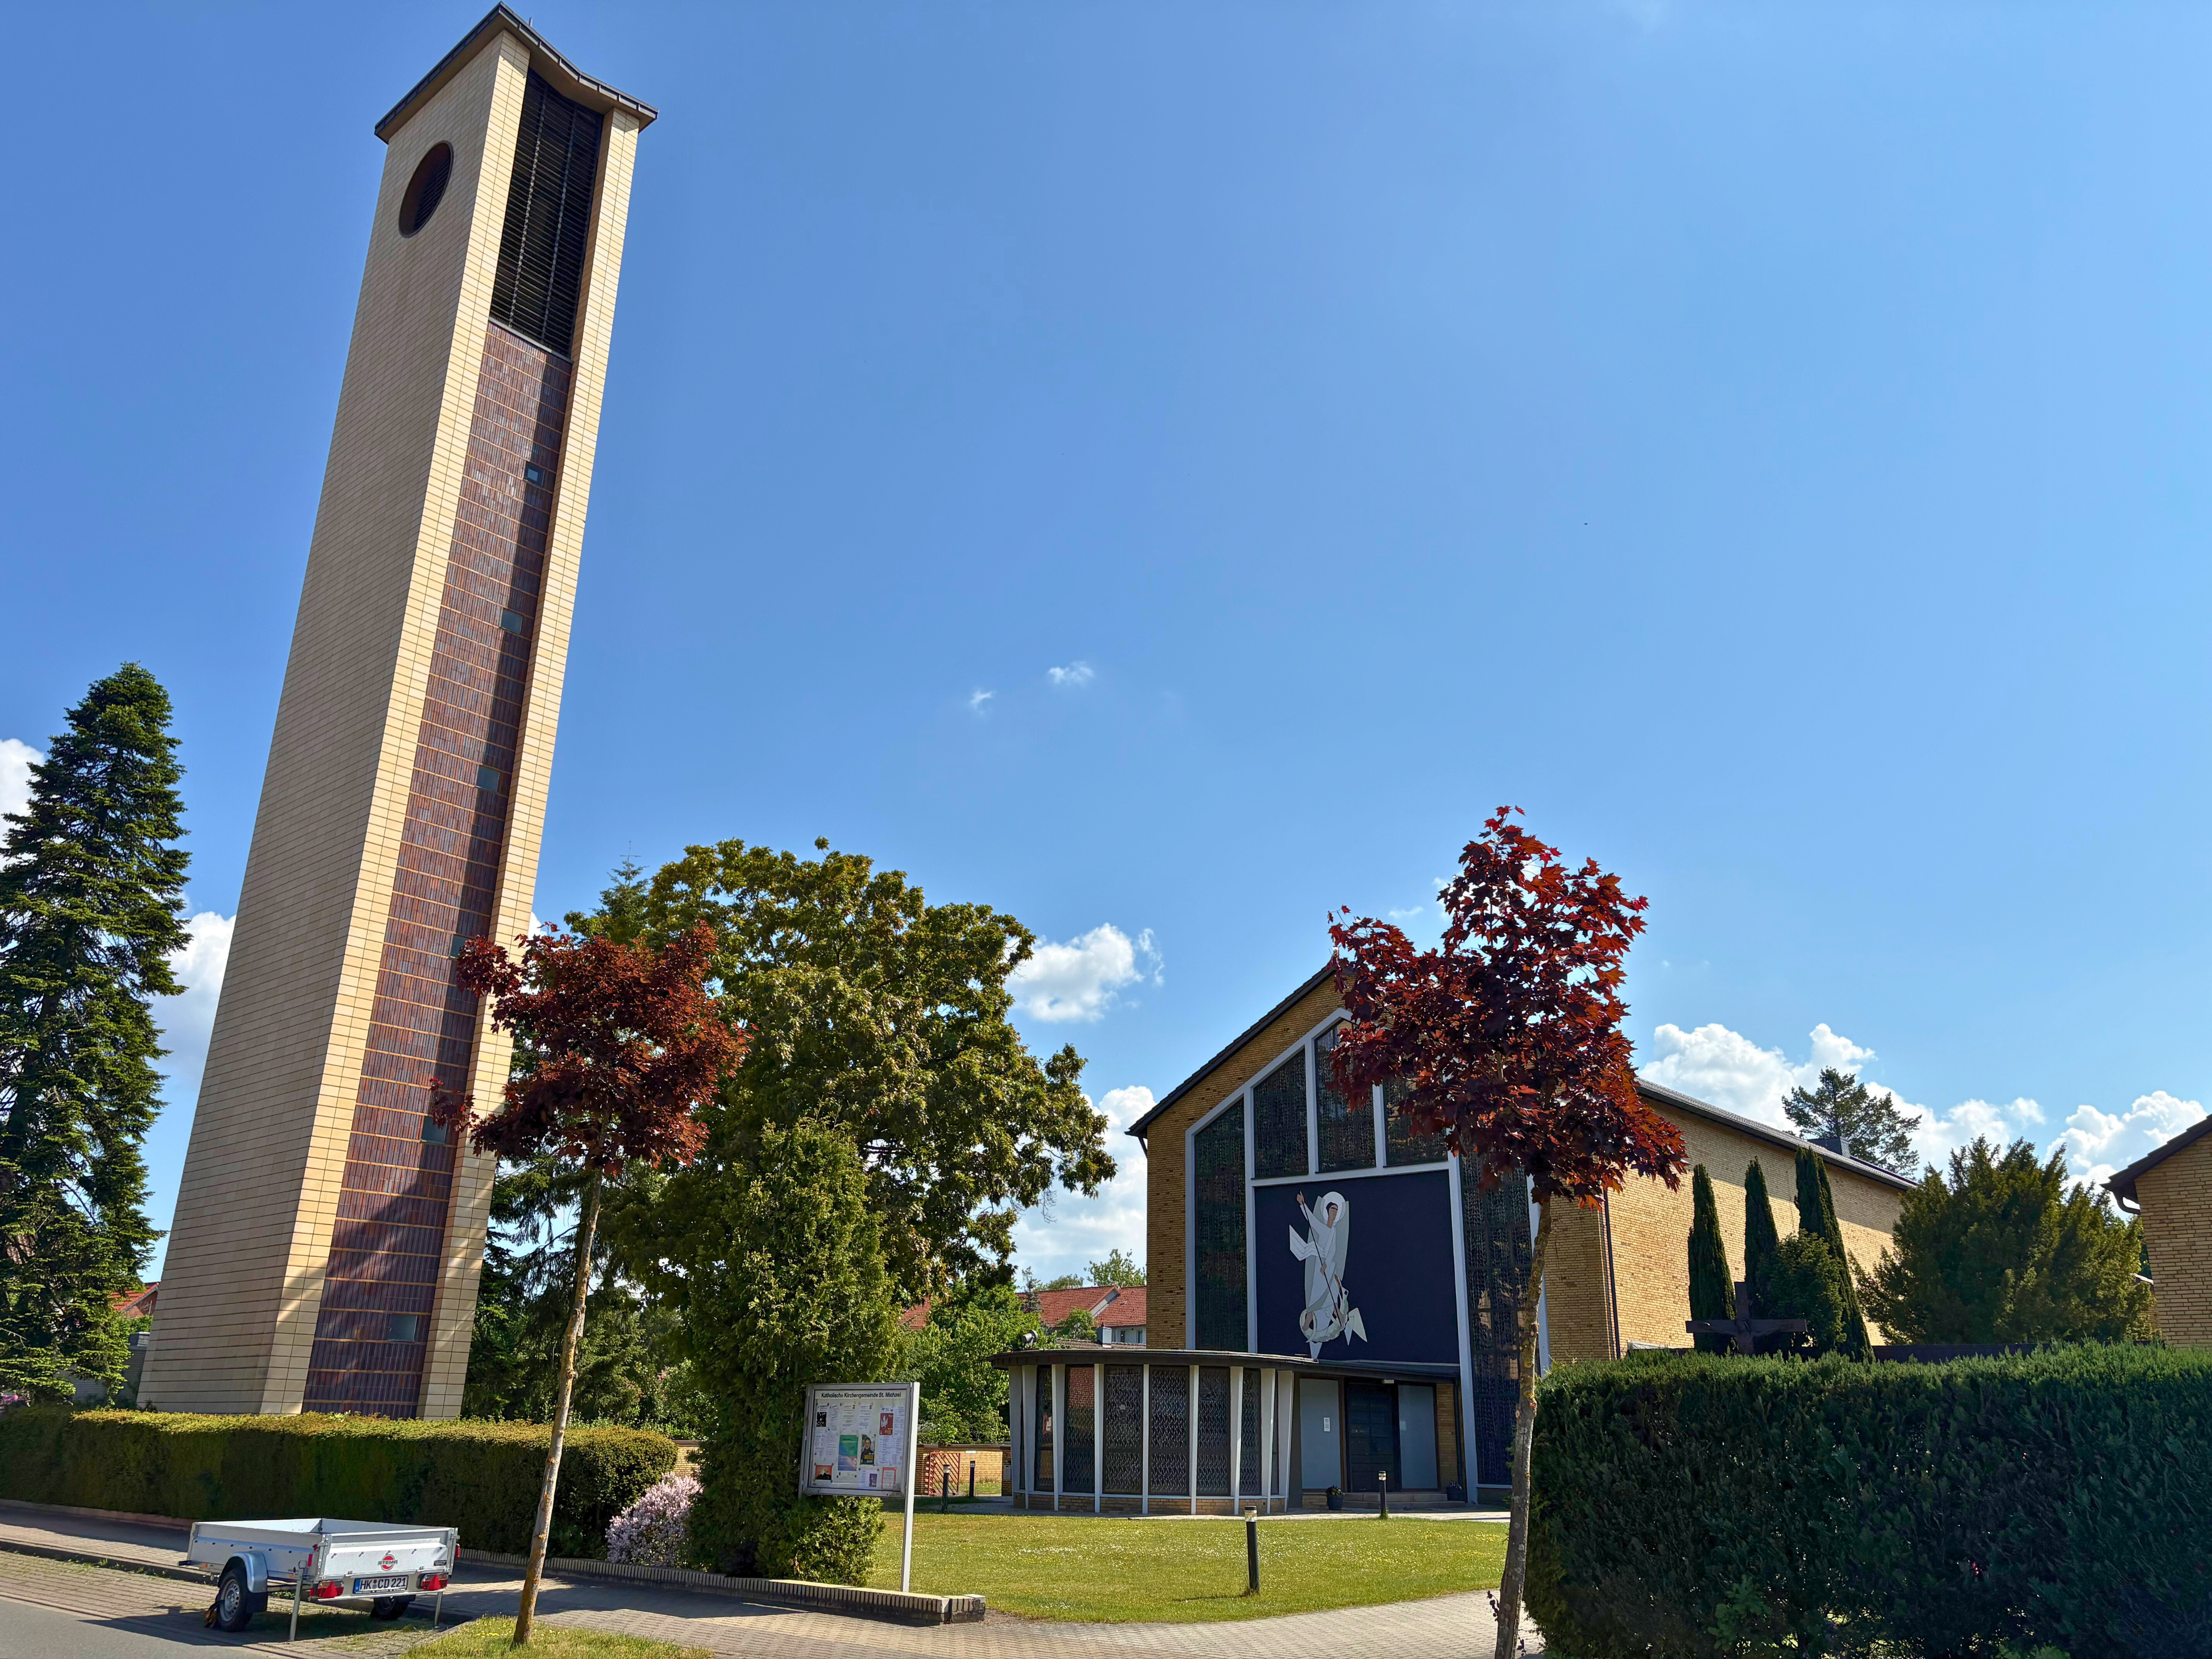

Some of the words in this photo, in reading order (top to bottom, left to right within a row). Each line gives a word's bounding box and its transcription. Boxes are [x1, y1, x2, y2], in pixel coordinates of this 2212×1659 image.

[360, 1579, 372, 1589] HK
[378, 1579, 390, 1589] CD
[391, 1577, 406, 1588] 221
